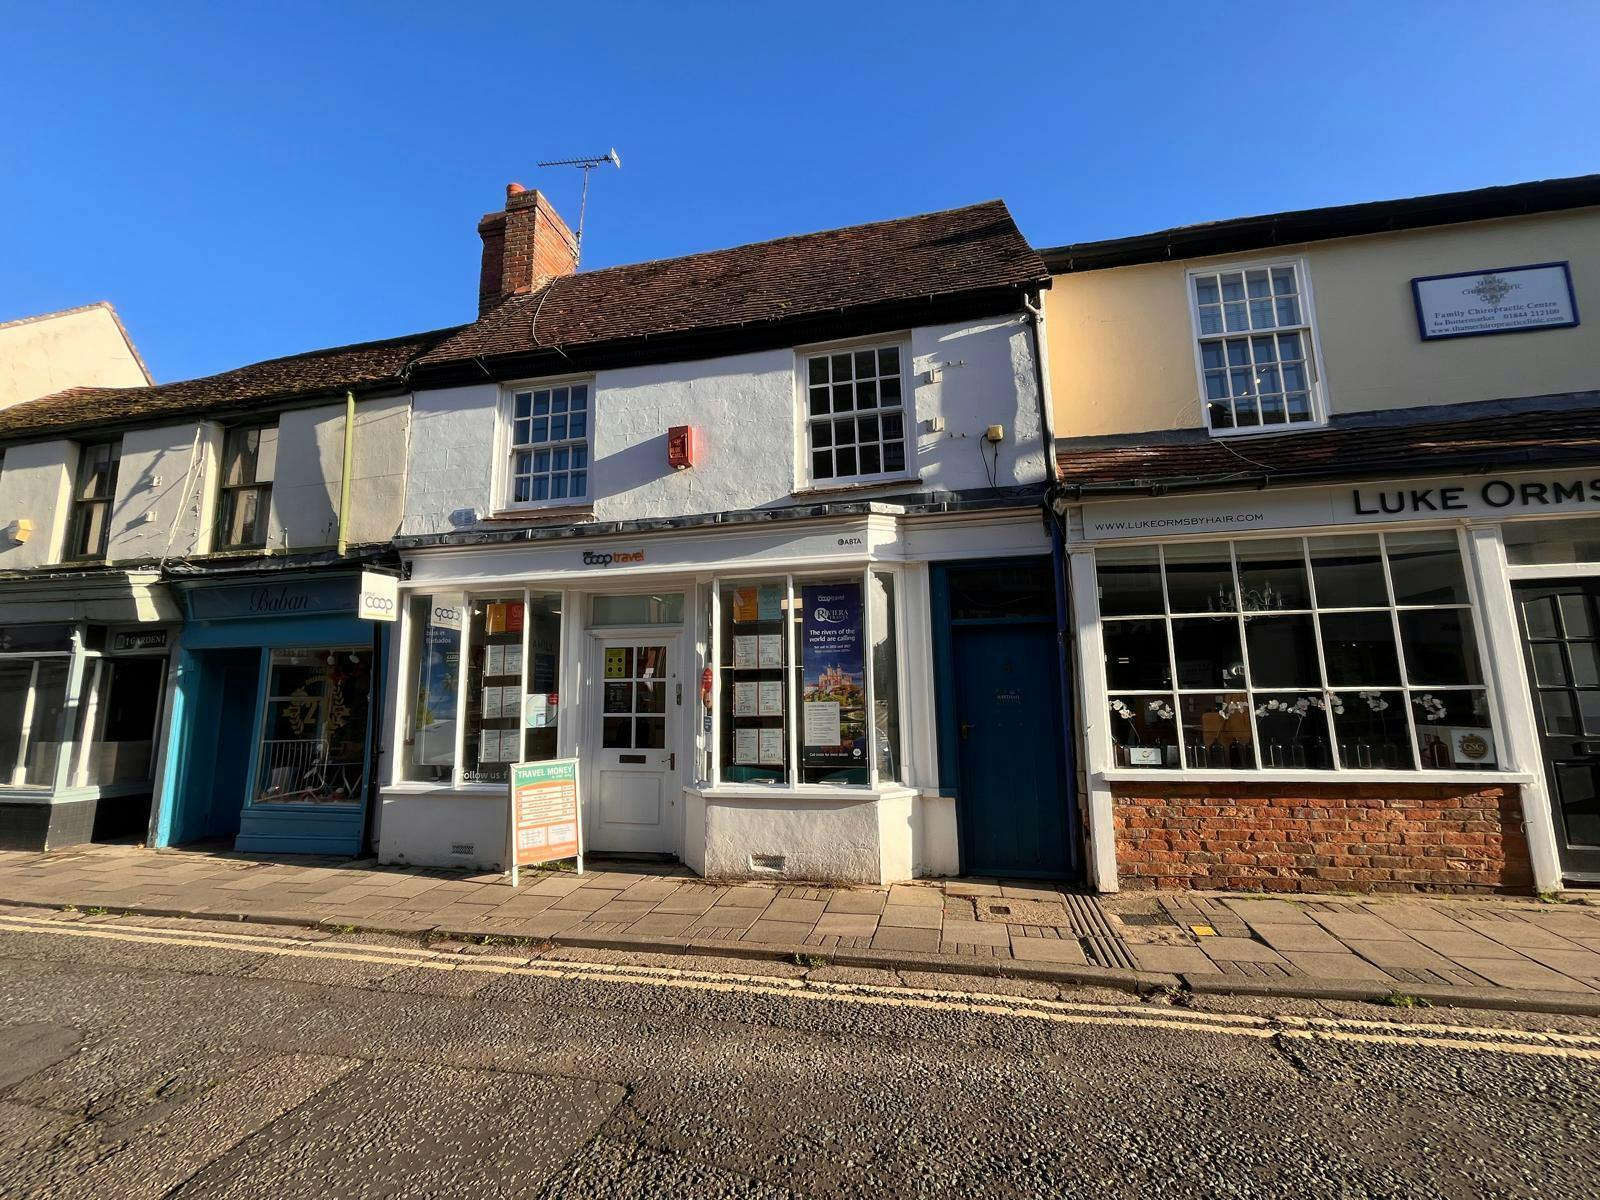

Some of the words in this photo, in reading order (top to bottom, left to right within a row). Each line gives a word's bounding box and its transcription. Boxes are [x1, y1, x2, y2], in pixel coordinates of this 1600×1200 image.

[1434, 309, 1465, 319] Family
[1467, 303, 1525, 316] Chiropractic
[1526, 301, 1558, 309] Centre
[1353, 487, 1468, 515] LUKE
[1095, 513, 1264, 531] WWW.LUKEORMSBYHAIR.COM
[613, 548, 645, 563] travel
[250, 586, 309, 613] Baban
[365, 596, 394, 614] coop
[837, 635, 856, 643] calling
[517, 768, 546, 779] TRAVEL
[547, 765, 573, 777] MONEY
